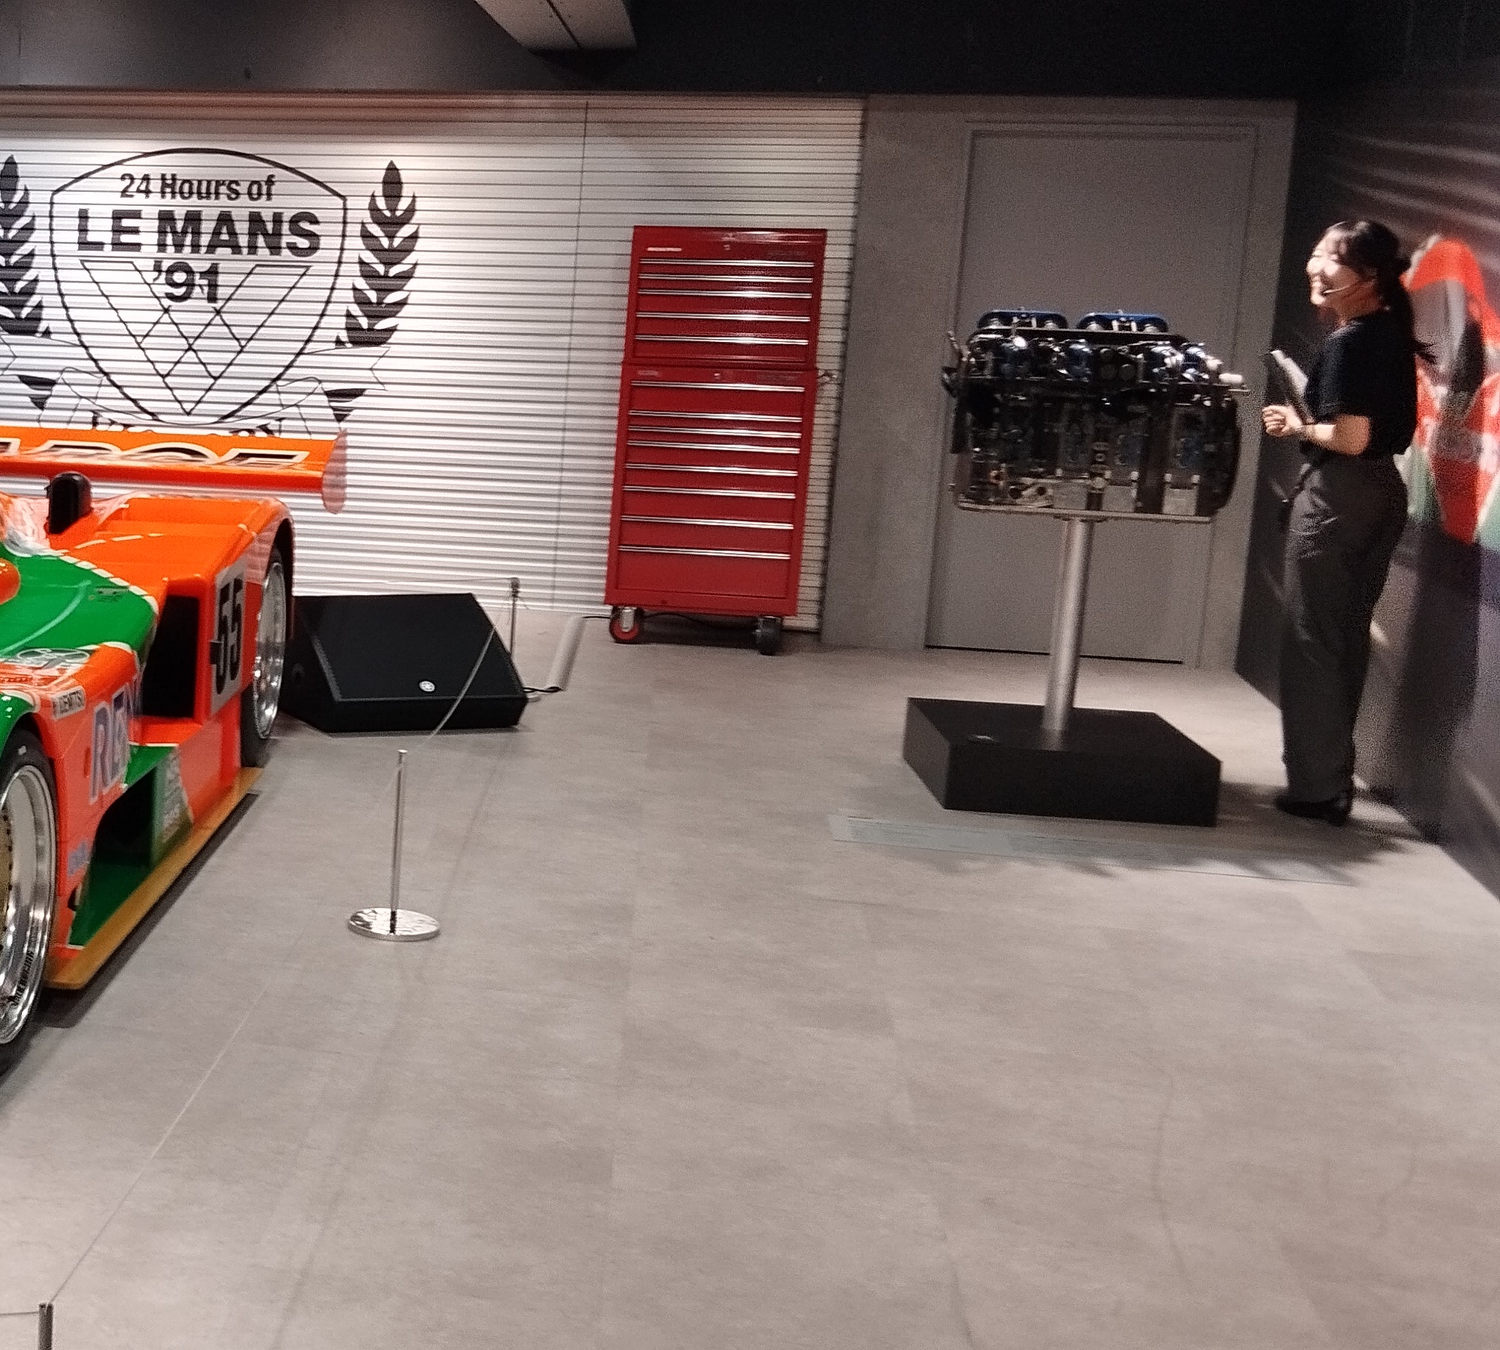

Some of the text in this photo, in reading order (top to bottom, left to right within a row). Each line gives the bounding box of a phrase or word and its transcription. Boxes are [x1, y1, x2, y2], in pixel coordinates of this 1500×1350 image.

[120, 173, 276, 202] 24 Hours of
[77, 208, 321, 257] LE MANS
[153, 260, 220, 304] '91
